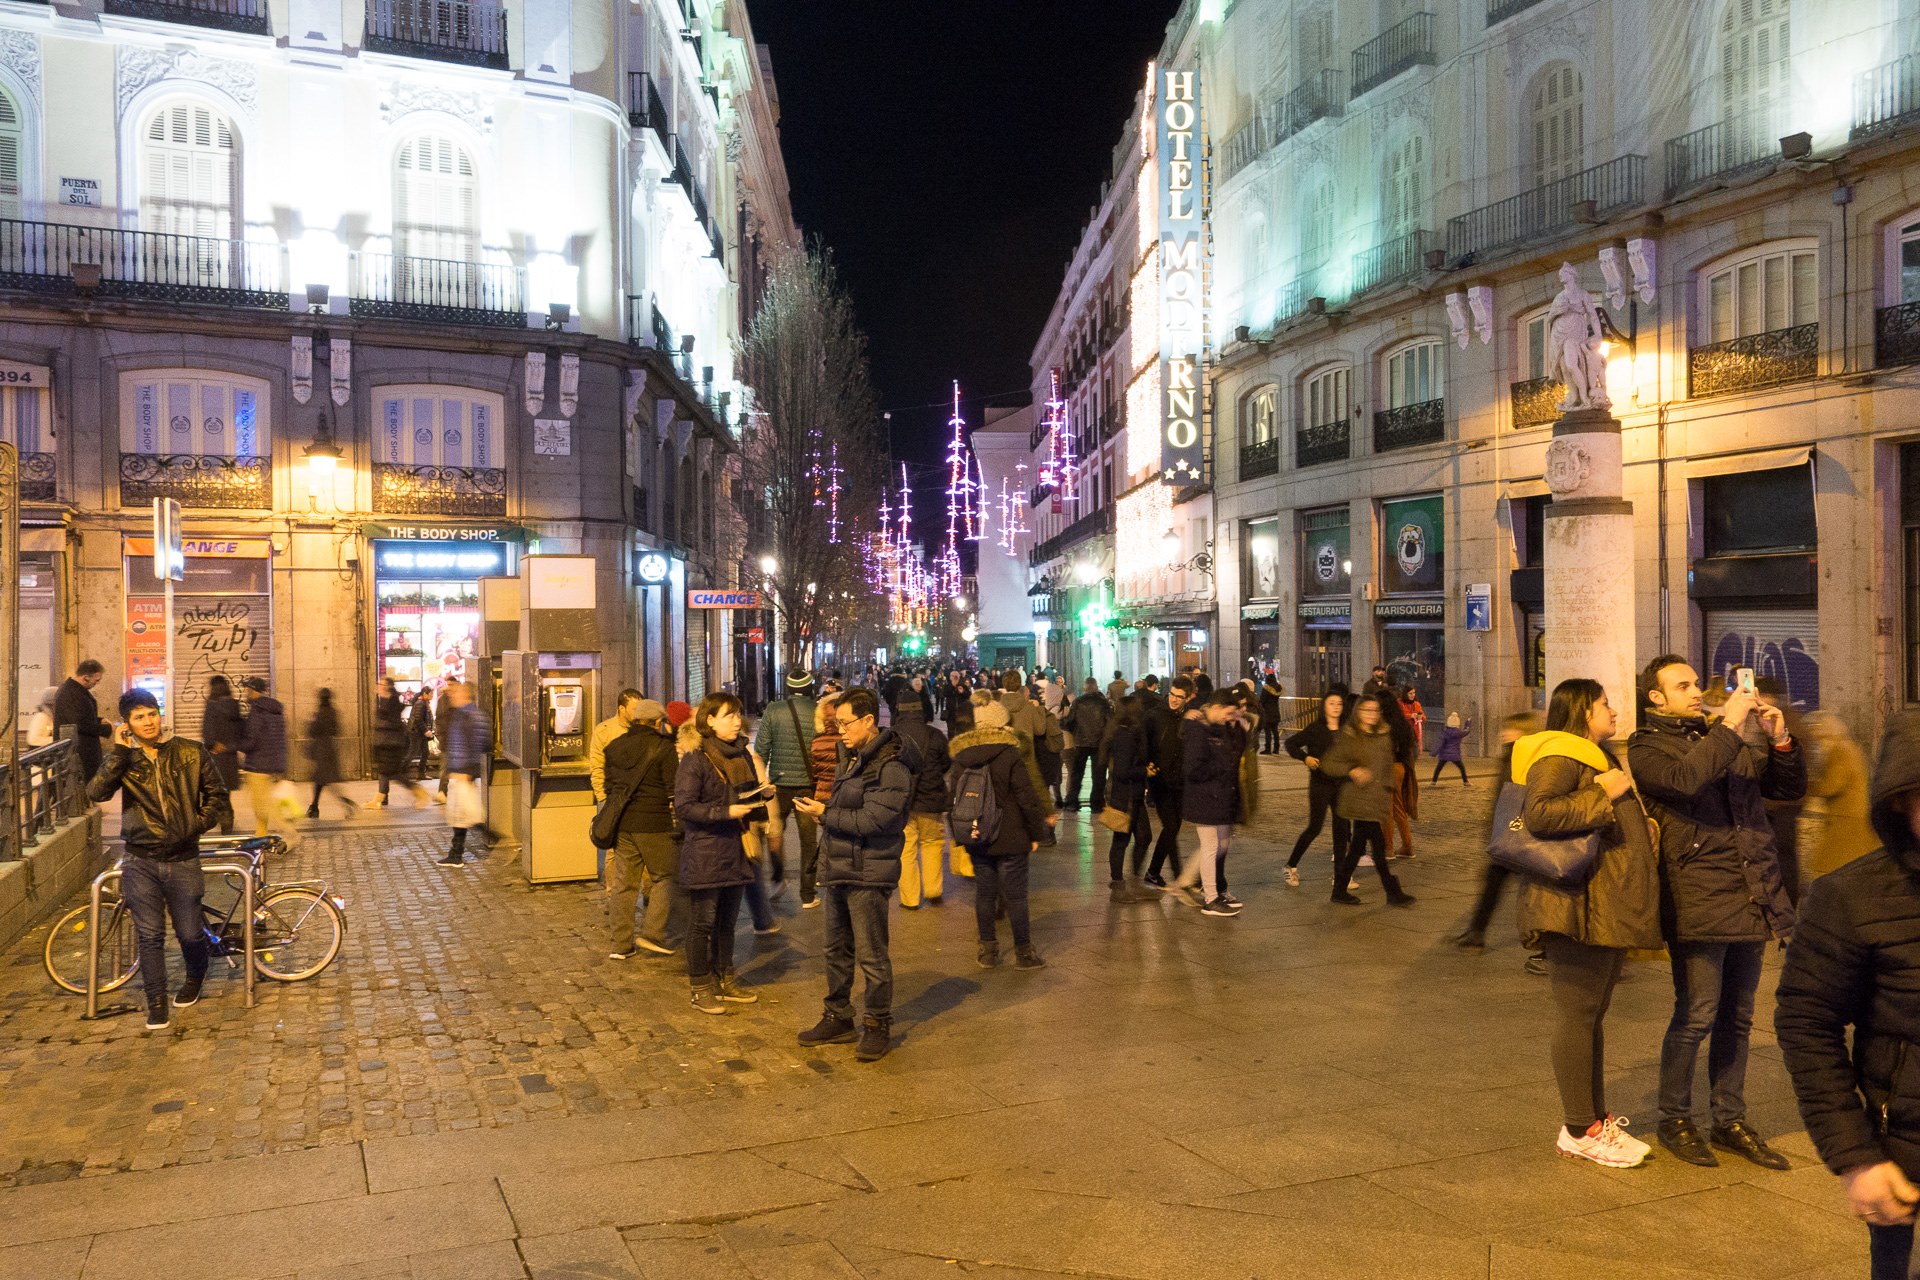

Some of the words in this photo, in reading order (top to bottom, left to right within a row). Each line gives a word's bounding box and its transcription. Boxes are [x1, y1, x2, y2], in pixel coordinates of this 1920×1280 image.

[1165, 71, 1194, 220] HOTEL
[62, 178, 98, 189] PUERTA
[72, 187, 88, 195] DEL
[69, 194, 91, 205] SOL
[1163, 240, 1198, 448] MODERNO
[142, 386, 151, 402] THE
[241, 391, 249, 407] THE
[142, 404, 151, 426] BODY
[390, 401, 398, 416] THE
[477, 405, 485, 420] THE
[390, 418, 398, 440] BODY
[477, 422, 485, 444] BODY
[387, 526, 416, 539] THE
[419, 527, 458, 540] BODY
[181, 541, 238, 553] ANGE
[416, 553, 456, 567] BODY
[693, 594, 756, 605] CHANGE
[133, 603, 163, 613] ATM
[1298, 606, 1350, 616] RESTAURANTE
[1375, 604, 1442, 615] MARISQUERIA
